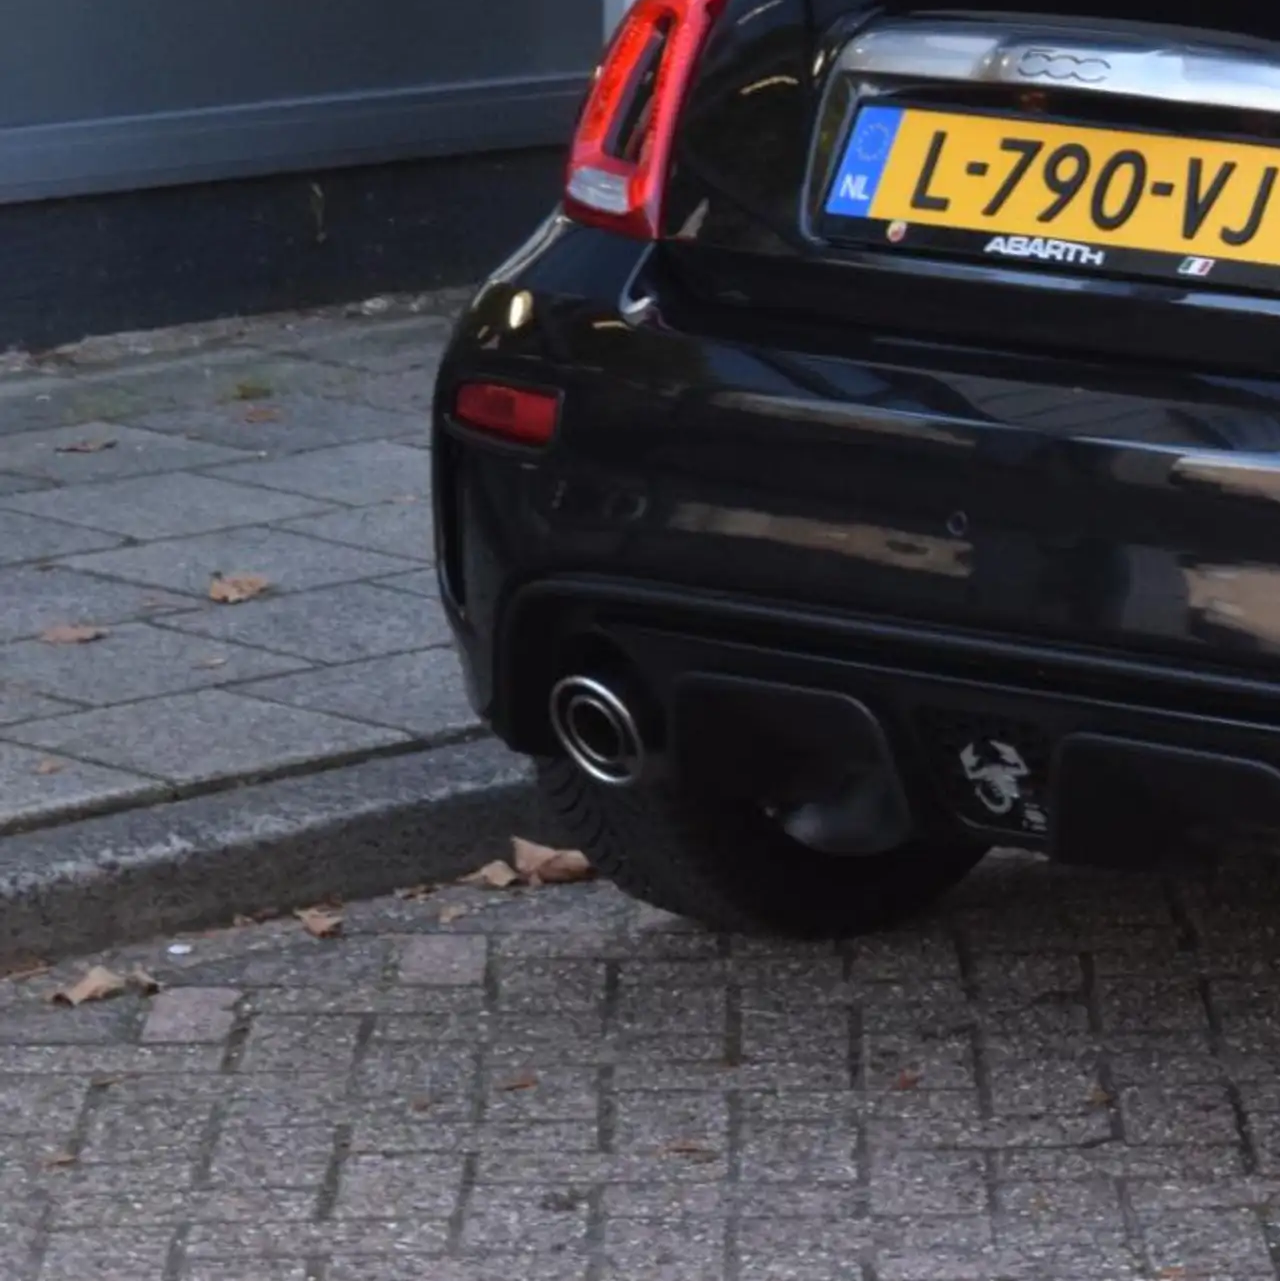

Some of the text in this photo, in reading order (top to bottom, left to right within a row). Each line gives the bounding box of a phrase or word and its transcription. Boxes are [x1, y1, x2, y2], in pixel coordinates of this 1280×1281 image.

[839, 173, 870, 203] NL
[909, 130, 1279, 247] L-790-VJ
[983, 235, 1105, 266] ABARTH
